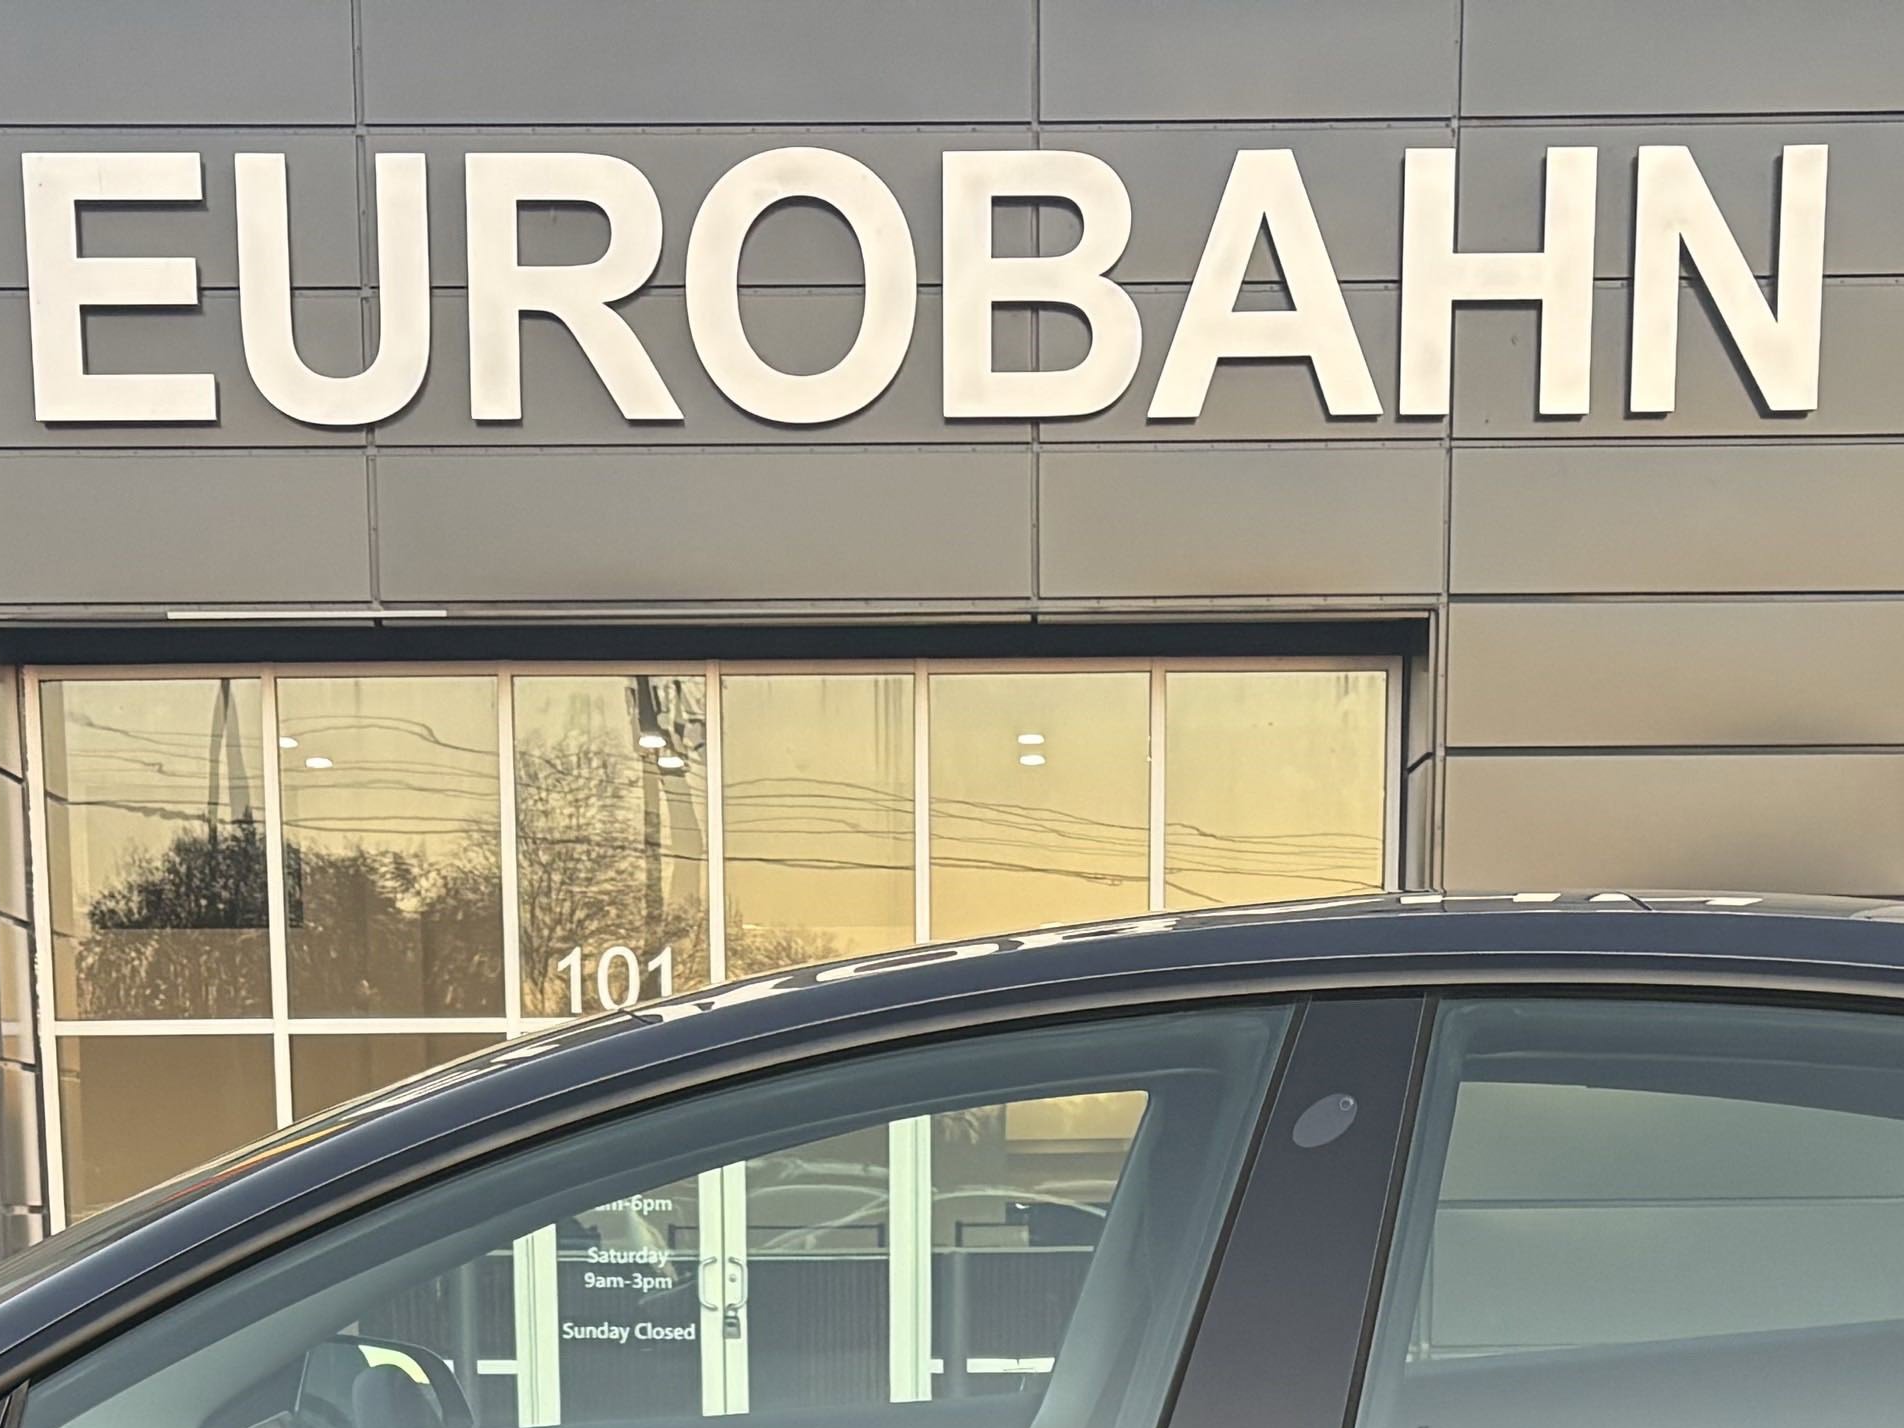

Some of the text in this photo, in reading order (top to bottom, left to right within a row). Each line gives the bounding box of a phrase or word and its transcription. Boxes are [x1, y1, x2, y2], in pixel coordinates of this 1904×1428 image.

[20, 145, 1830, 427] EUROBAHN
[557, 945, 673, 1014] 101
[587, 1246, 669, 1268] Saturday
[584, 1272, 673, 1293] 9am-3pm
[562, 1322, 696, 1344] Sunday Closed
